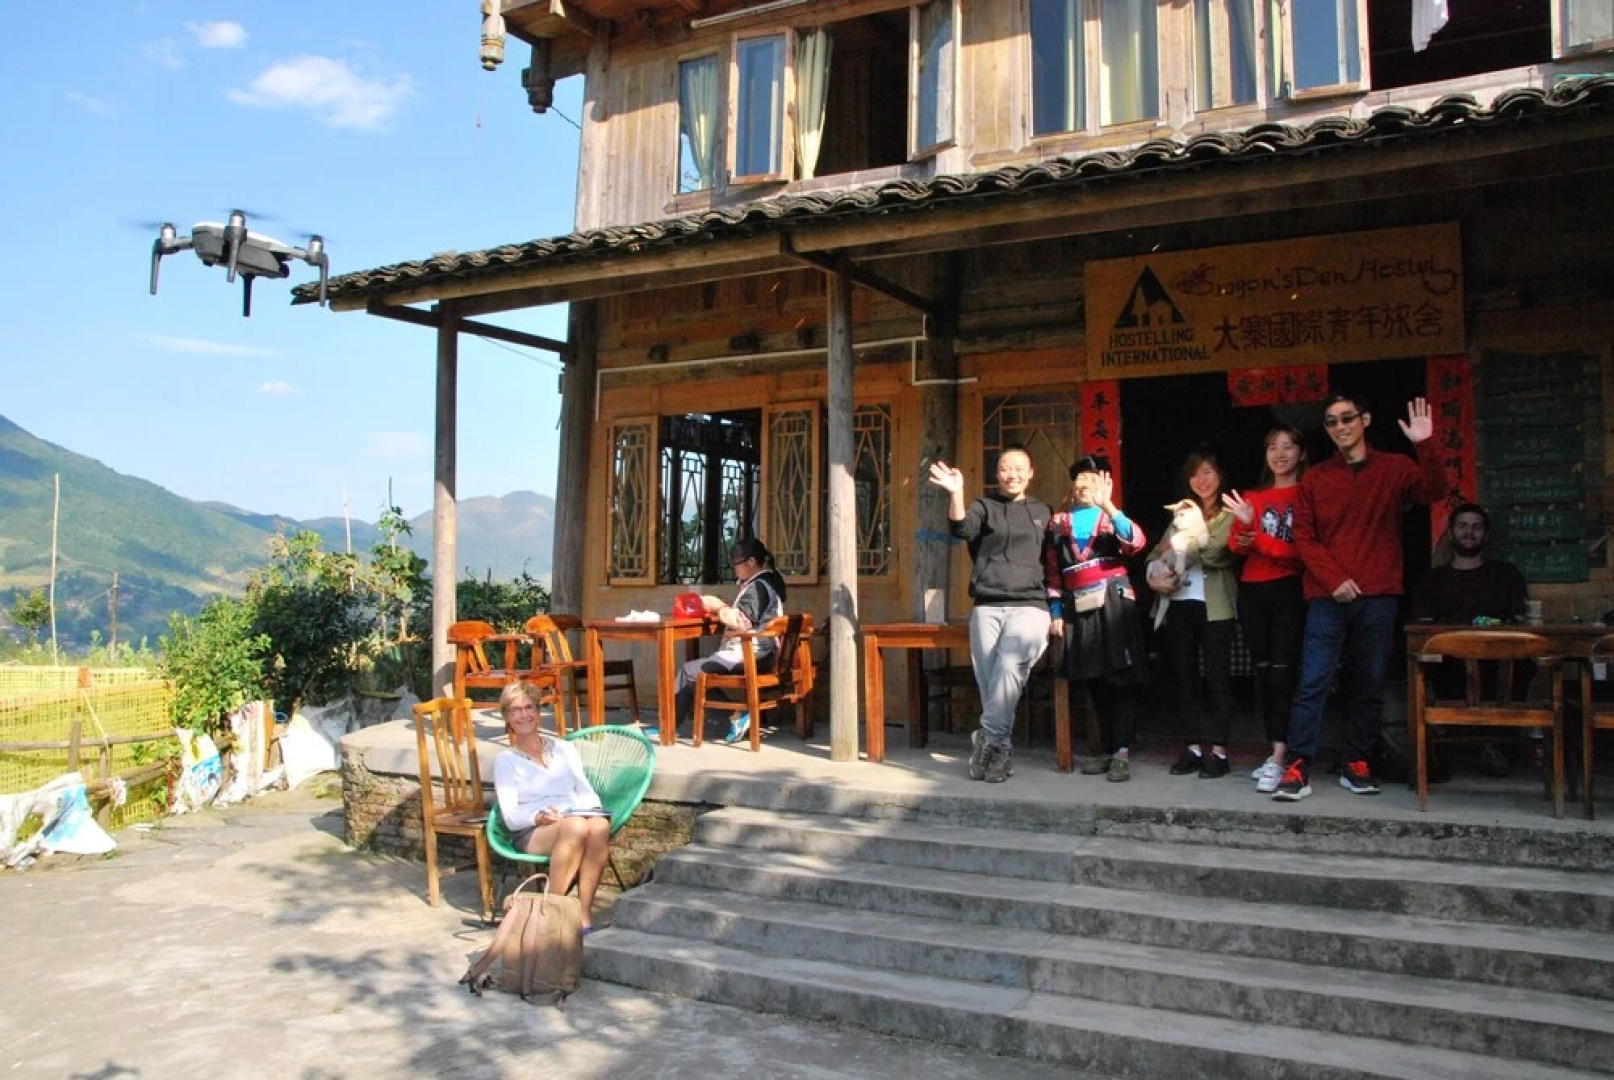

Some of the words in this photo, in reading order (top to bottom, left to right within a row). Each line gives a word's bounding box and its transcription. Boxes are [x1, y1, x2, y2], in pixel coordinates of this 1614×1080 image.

[1292, 267, 1347, 288] Den
[1350, 254, 1461, 296] Hostel
[1109, 328, 1194, 350] HOSTELLING
[1101, 344, 1210, 367] INTERNATIONAL
